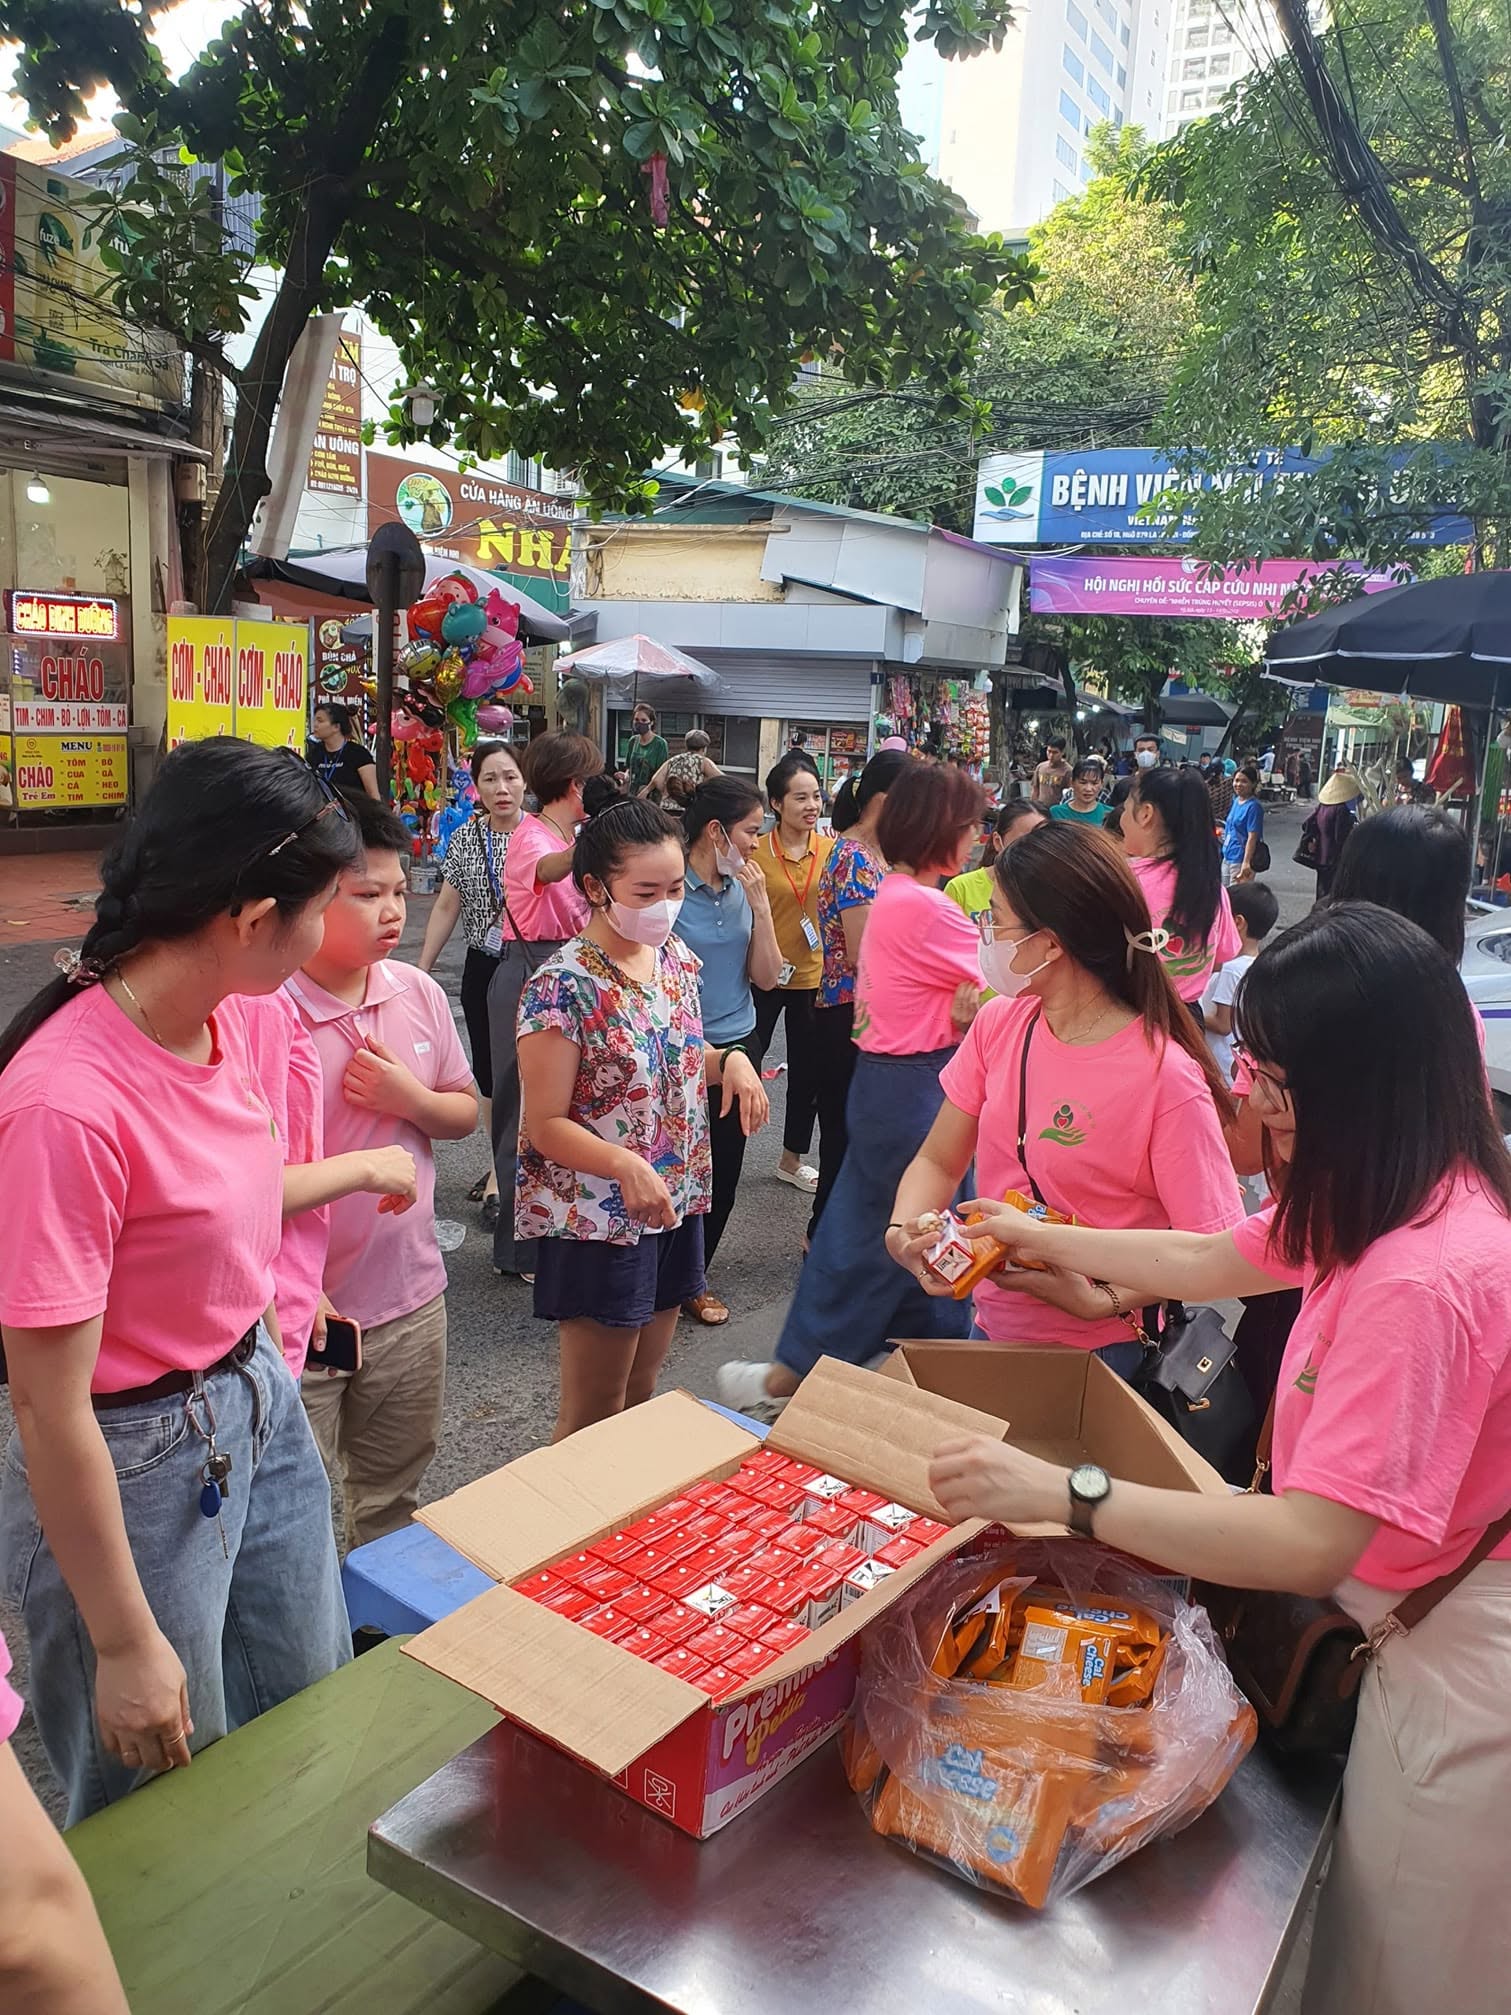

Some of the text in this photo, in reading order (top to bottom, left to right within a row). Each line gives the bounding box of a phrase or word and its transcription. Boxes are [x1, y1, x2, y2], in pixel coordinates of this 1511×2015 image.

[460, 479, 486, 503] CỬA
[488, 487, 522, 510] HÀNG
[1051, 468, 1128, 512] BỆNH
[1084, 575, 1106, 594] HỘI
[1109, 578, 1140, 595] NGHỊ
[1168, 577, 1193, 594] SỨC
[1223, 578, 1250, 596] CỨU
[1252, 581, 1277, 596] NHI
[41, 646, 104, 702] CHÁO
[171, 638, 194, 701] CƠM
[204, 632, 231, 705] CHÁO
[238, 643, 265, 708] CƠM
[274, 640, 303, 710] CHÁO
[15, 708, 29, 726] TIM
[36, 708, 55, 726] CHIM
[97, 705, 111, 727] TÔM
[61, 741, 93, 752] MENU
[66, 759, 86, 767] TÔM
[18, 761, 53, 788] CHÁO
[41, 792, 56, 800] Em
[67, 793, 84, 801] TIM
[102, 791, 124, 800] CHIM
[1082, 1644, 1098, 1687] Cheese
[1092, 1658, 1105, 1679] Cal
